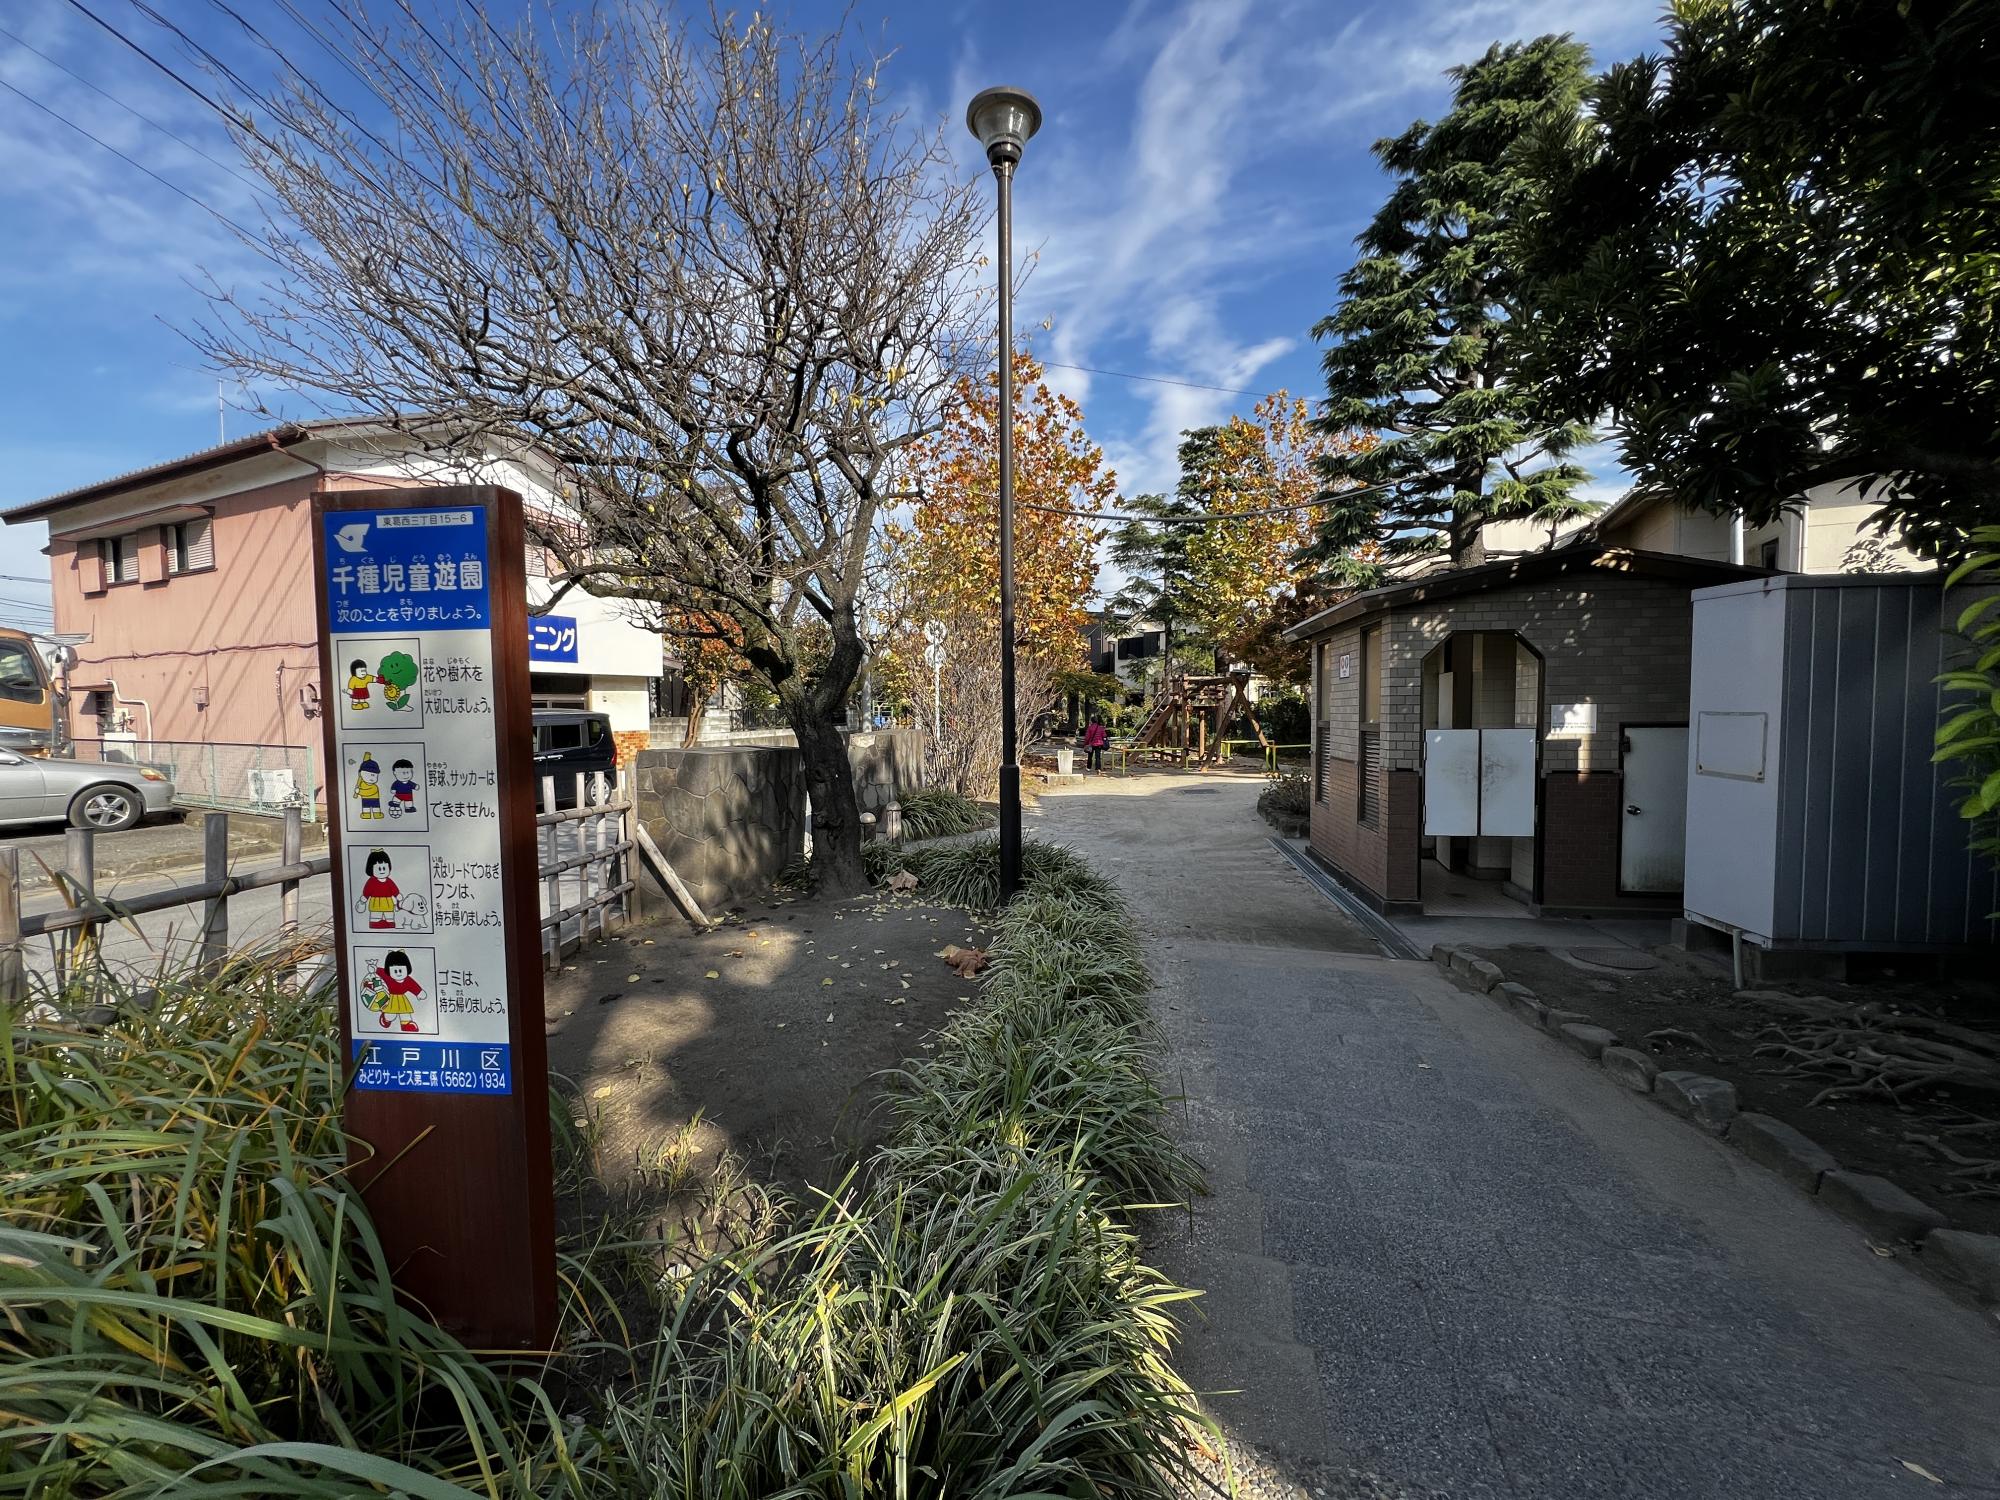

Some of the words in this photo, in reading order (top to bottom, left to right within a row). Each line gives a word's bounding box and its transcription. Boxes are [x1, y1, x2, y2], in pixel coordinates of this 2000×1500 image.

[332, 560, 483, 595] 千種児童遊園
[337, 605, 482, 623] 次のことを守りましょう。
[423, 664, 483, 683] 花や樹木を
[425, 697, 491, 714] 大切にしましょう。
[428, 769, 495, 787] 野球、サッカーは
[430, 801, 496, 818] できません。
[433, 862, 500, 879] 犬はリードでつなぎ
[434, 883, 475, 899] フンは、
[435, 910, 502, 927] 持ち帰りましょう。
[438, 969, 479, 987] ゴミは、
[439, 997, 505, 1014] 持ち帰りましょう。
